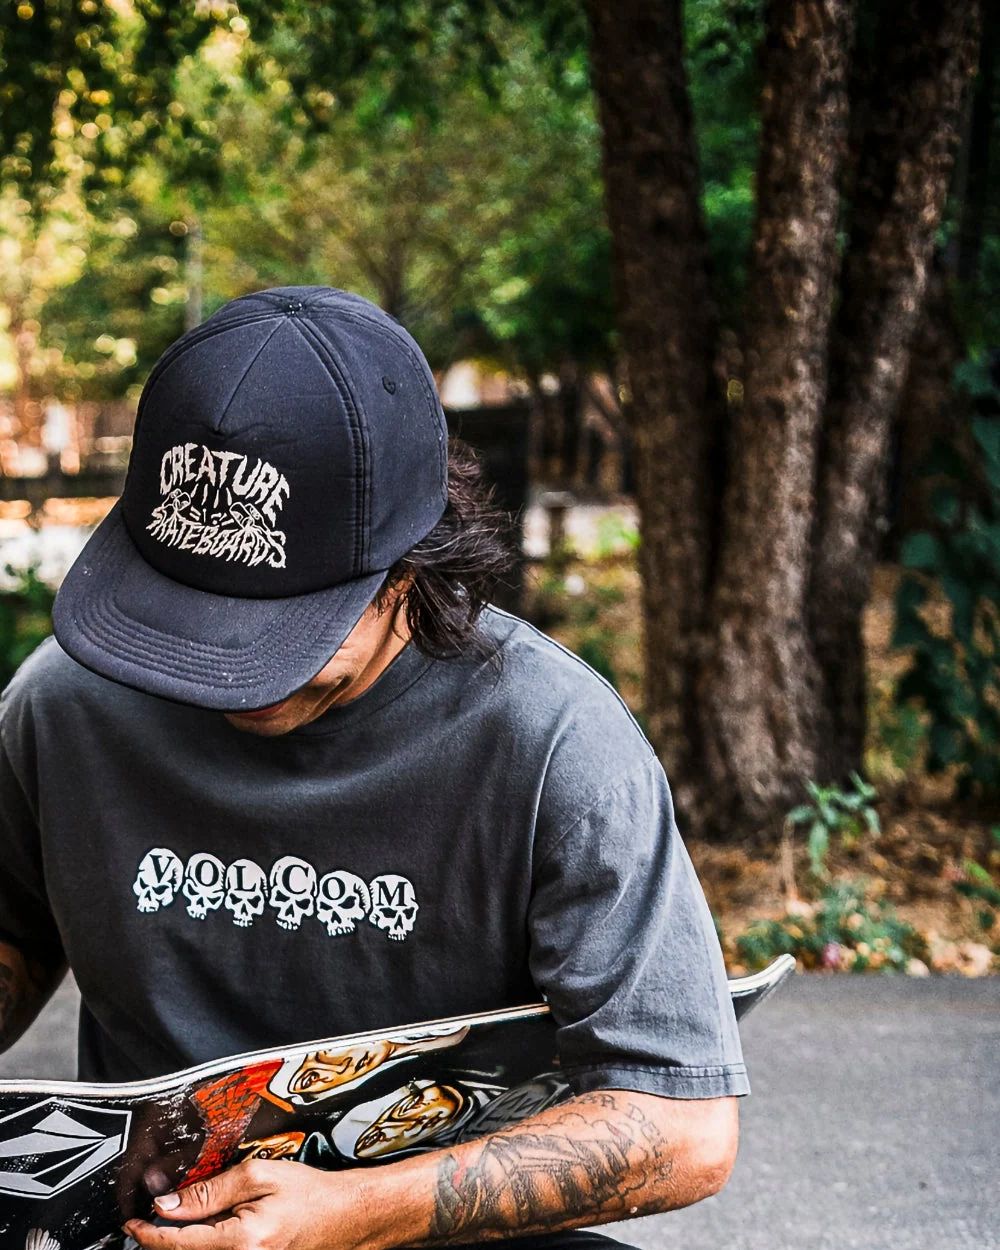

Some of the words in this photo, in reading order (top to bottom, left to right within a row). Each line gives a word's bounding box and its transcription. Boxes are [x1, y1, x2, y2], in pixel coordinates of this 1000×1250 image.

[160, 442, 290, 528] CREATURE
[146, 506, 287, 569] SKATEBOARDS
[149, 854, 409, 907] VOLCOM
